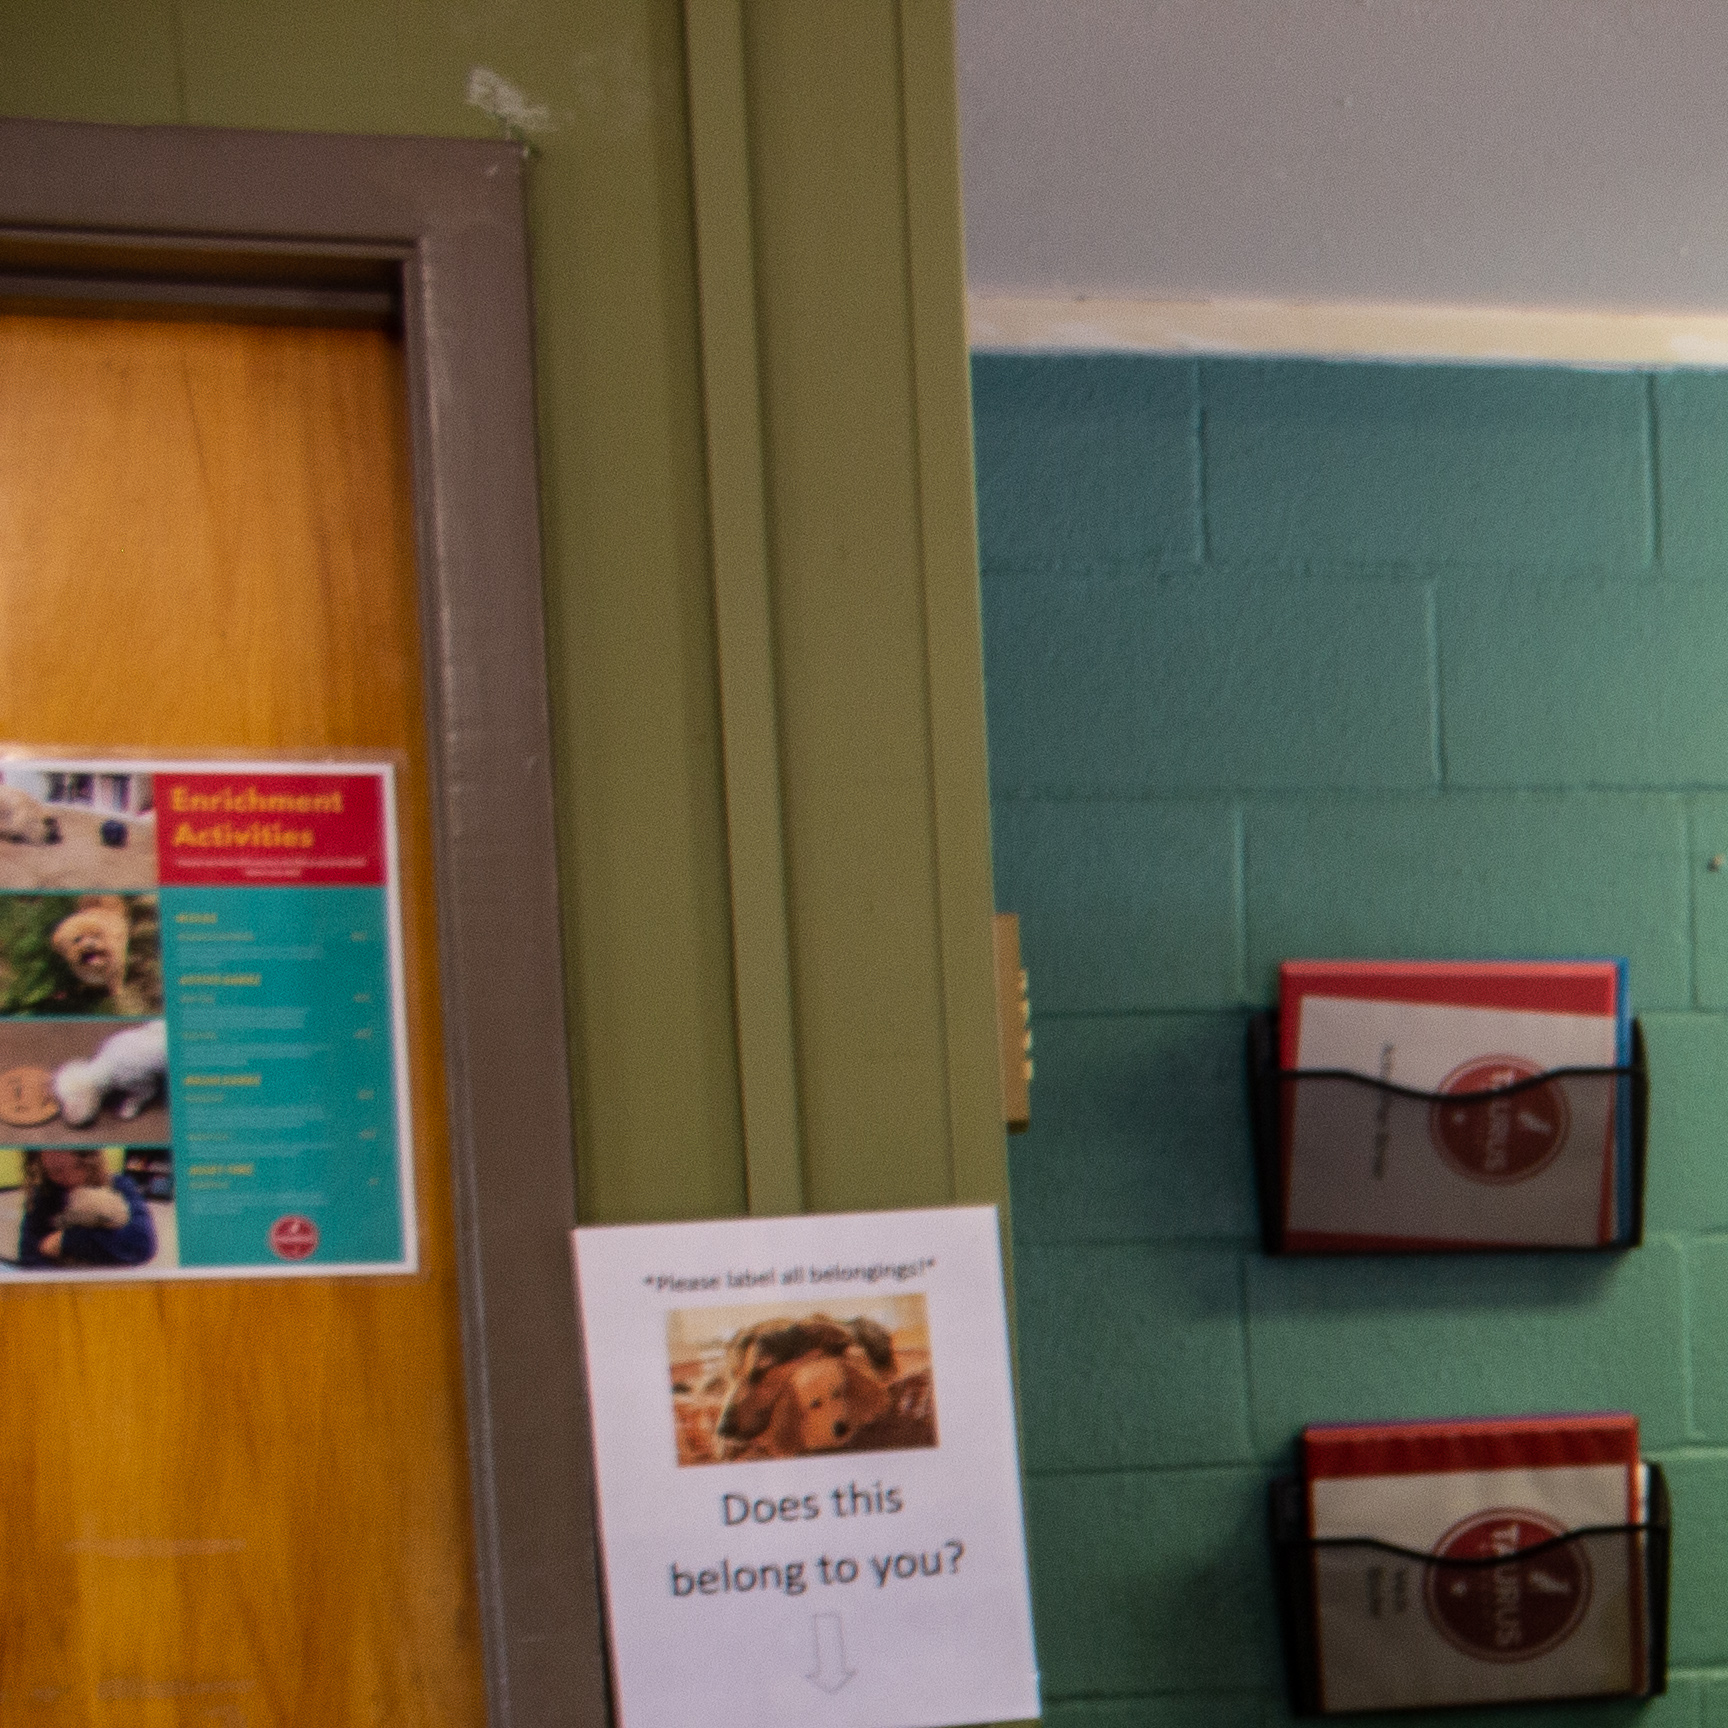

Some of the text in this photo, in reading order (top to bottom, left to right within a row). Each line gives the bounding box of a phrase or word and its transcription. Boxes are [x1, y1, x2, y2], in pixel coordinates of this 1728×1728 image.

[171, 786, 343, 813] Enrichment
[172, 822, 315, 847] Activities
[780, 1265, 804, 1285] all
[722, 1480, 903, 1526] Does this
[669, 1539, 965, 1597] belong to you?
